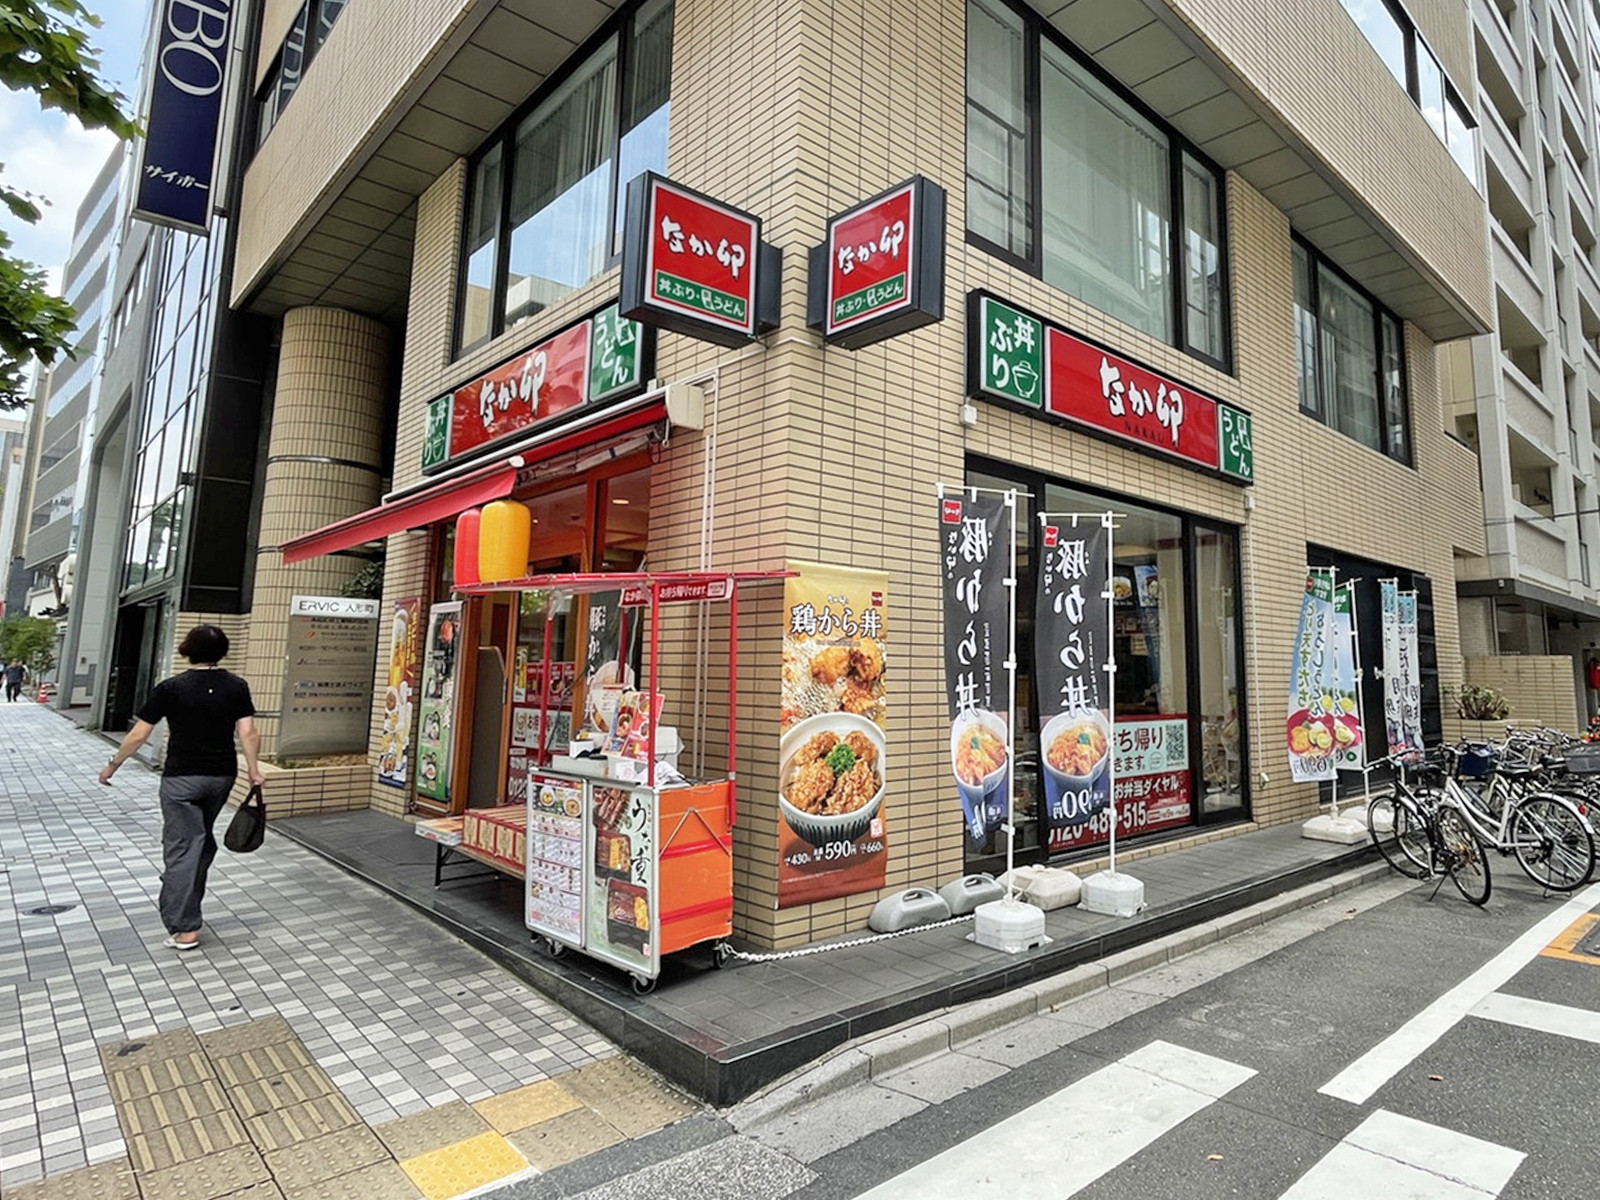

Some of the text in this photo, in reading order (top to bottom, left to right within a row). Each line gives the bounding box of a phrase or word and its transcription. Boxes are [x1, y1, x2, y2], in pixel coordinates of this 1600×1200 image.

[661, 214, 747, 281] なか卯
[837, 219, 905, 275] なか卯
[479, 350, 547, 428] なか卯
[1099, 356, 1185, 449] なか卯
[299, 600, 340, 613] ERVIC
[790, 603, 883, 638] 鶏から丼
[1113, 726, 1163, 753] ち帰り
[1114, 774, 1180, 799] お弁当ダイヤル
